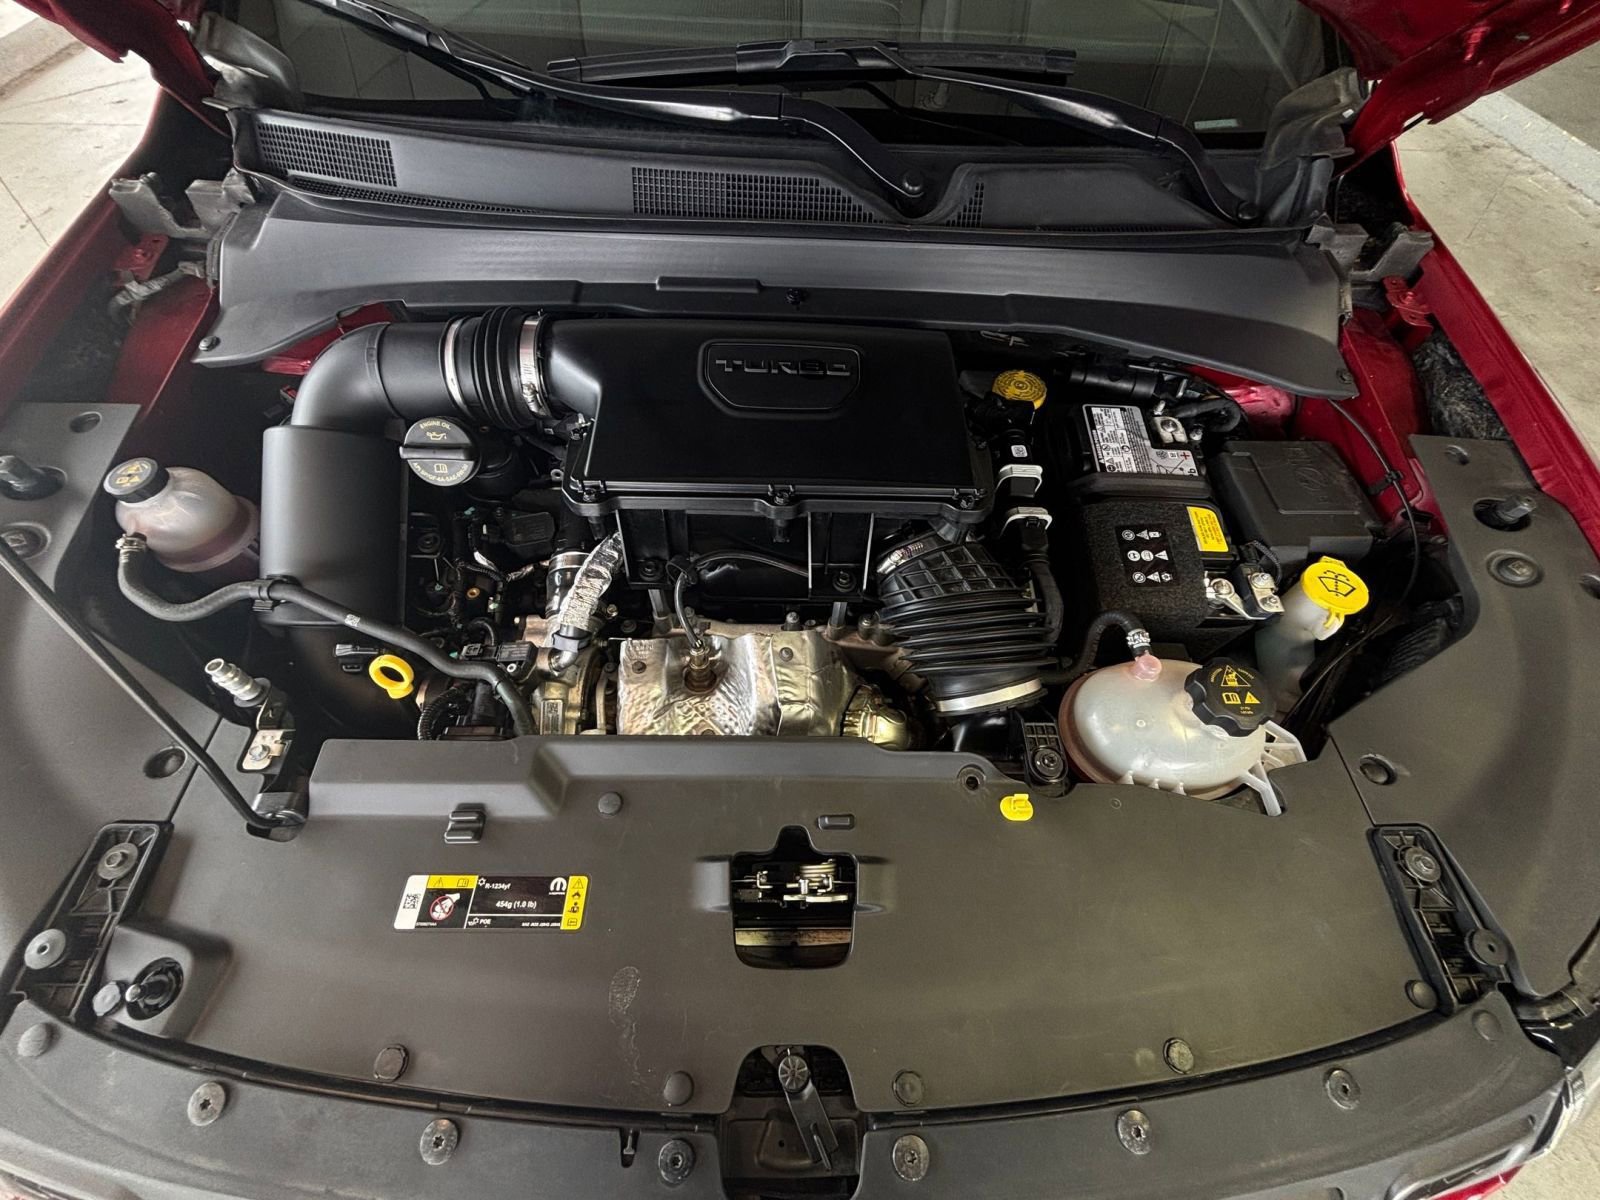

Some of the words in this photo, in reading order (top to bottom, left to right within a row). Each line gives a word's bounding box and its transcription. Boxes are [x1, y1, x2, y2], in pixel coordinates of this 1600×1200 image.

[715, 359, 851, 376] TURBO
[419, 420, 441, 430] ENGINE
[441, 421, 452, 431] OIL
[484, 882, 511, 891] R-1234yf
[495, 900, 513, 909] 454g
[513, 900, 527, 909] (1.0
[527, 900, 538, 909] lb)
